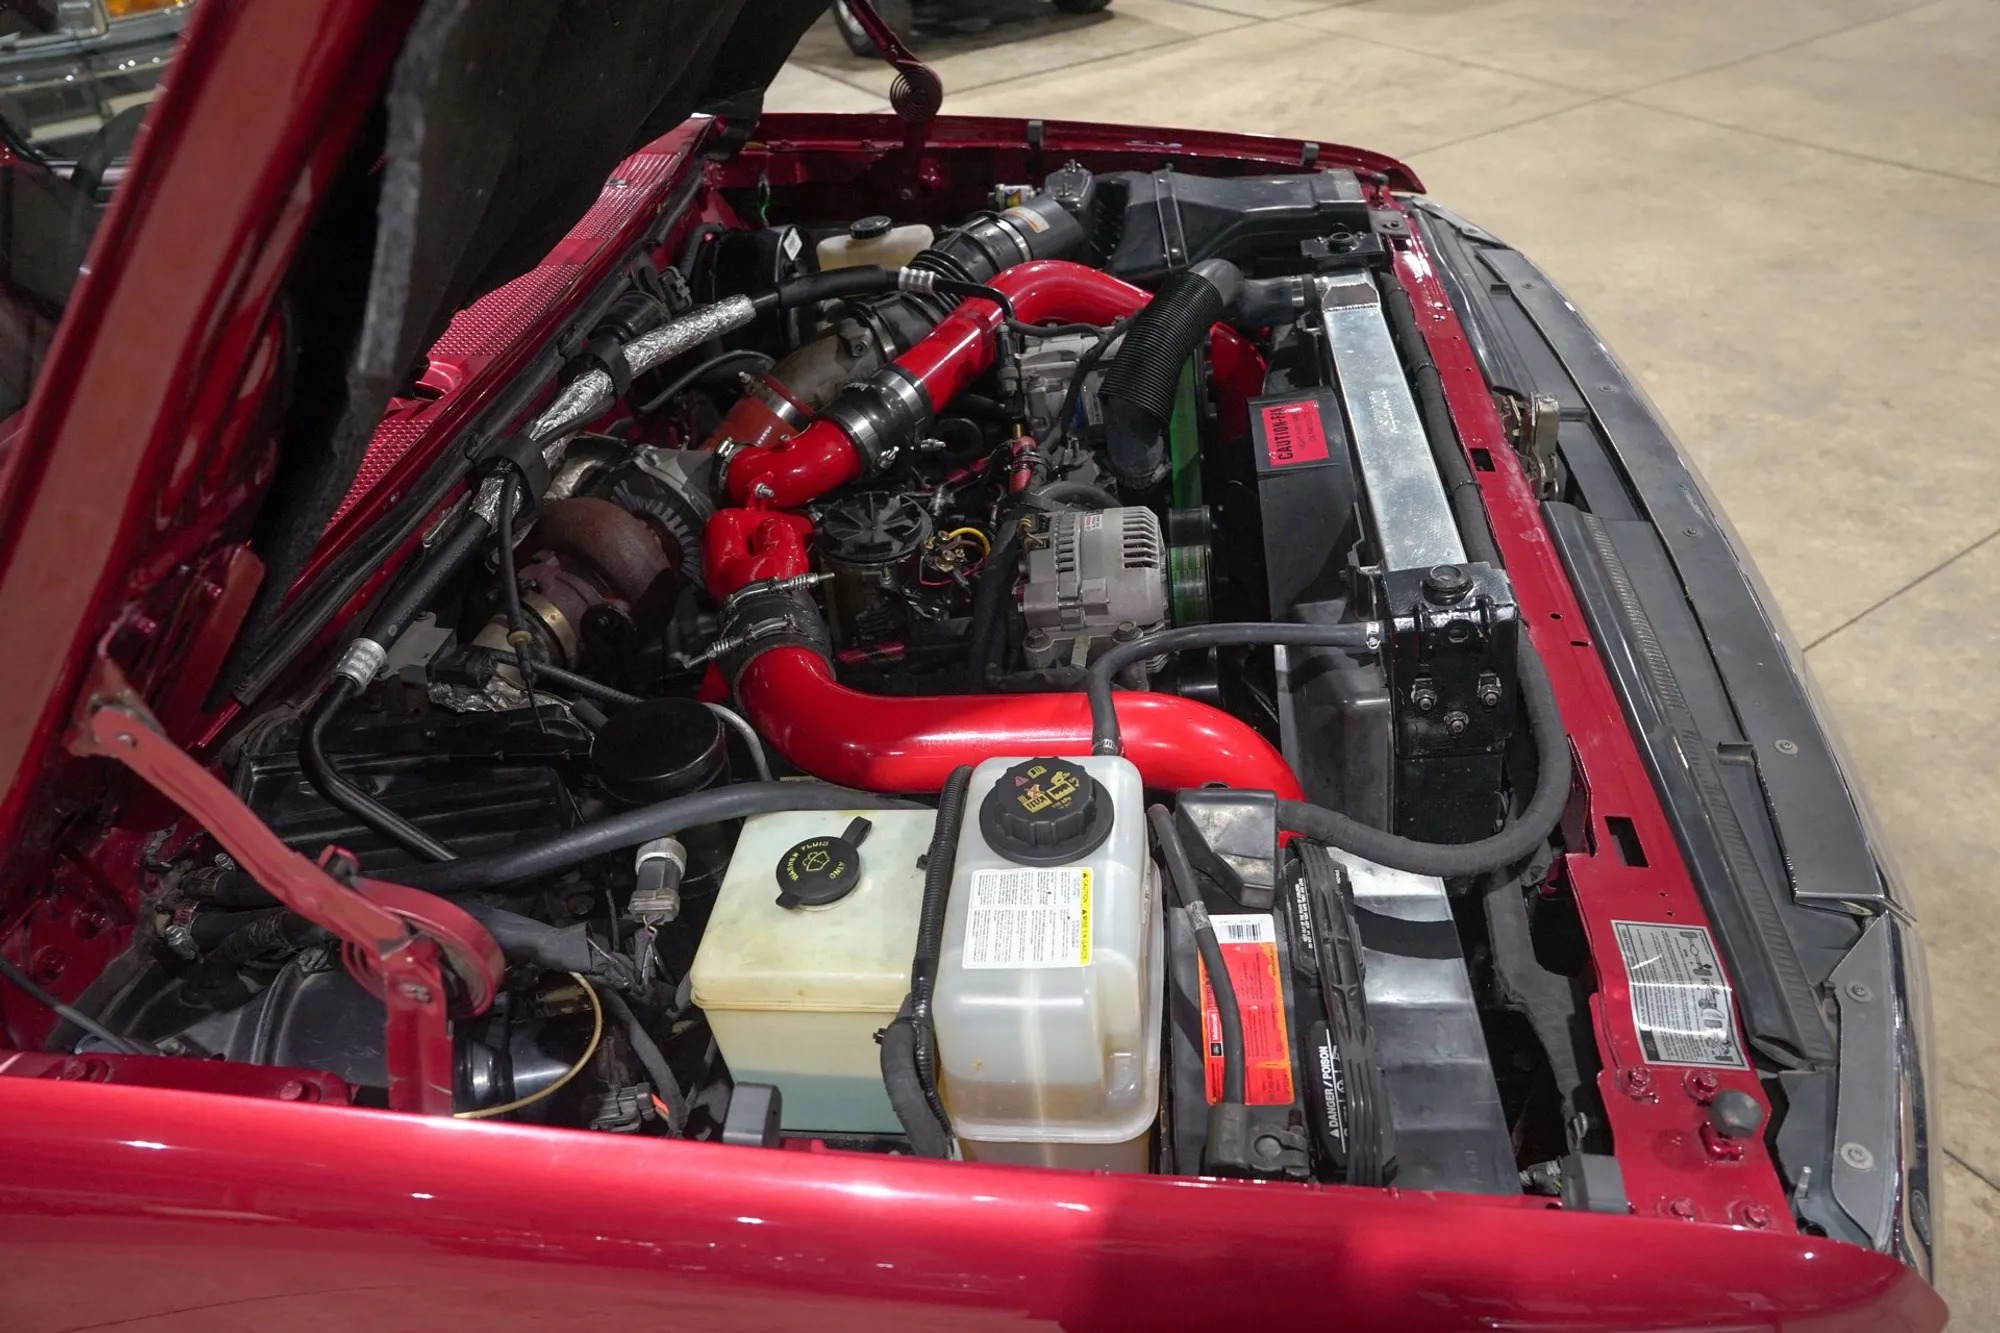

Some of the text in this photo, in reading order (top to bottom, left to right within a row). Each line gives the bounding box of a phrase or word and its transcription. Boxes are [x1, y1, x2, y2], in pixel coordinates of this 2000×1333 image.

[786, 841, 846, 881] WASHER FLUID ONLY
[1319, 1046, 1333, 1080] POISON
[1325, 1088, 1339, 1127] DANGER
